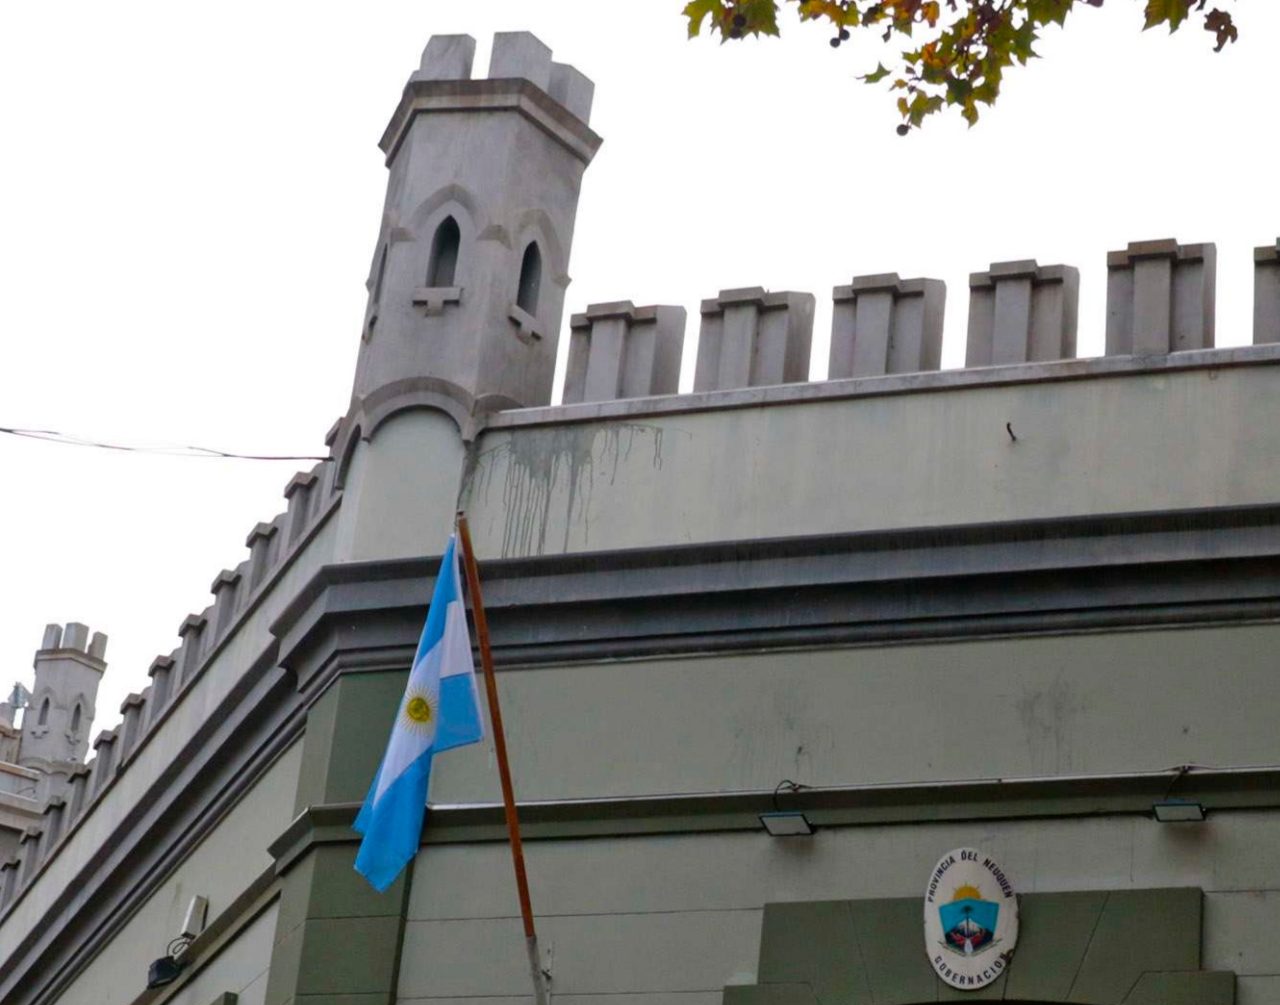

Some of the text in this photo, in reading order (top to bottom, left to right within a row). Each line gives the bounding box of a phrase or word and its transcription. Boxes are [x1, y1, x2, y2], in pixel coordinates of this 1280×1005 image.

[928, 850, 1014, 903] PROVINCIA DEL NEUQUEN
